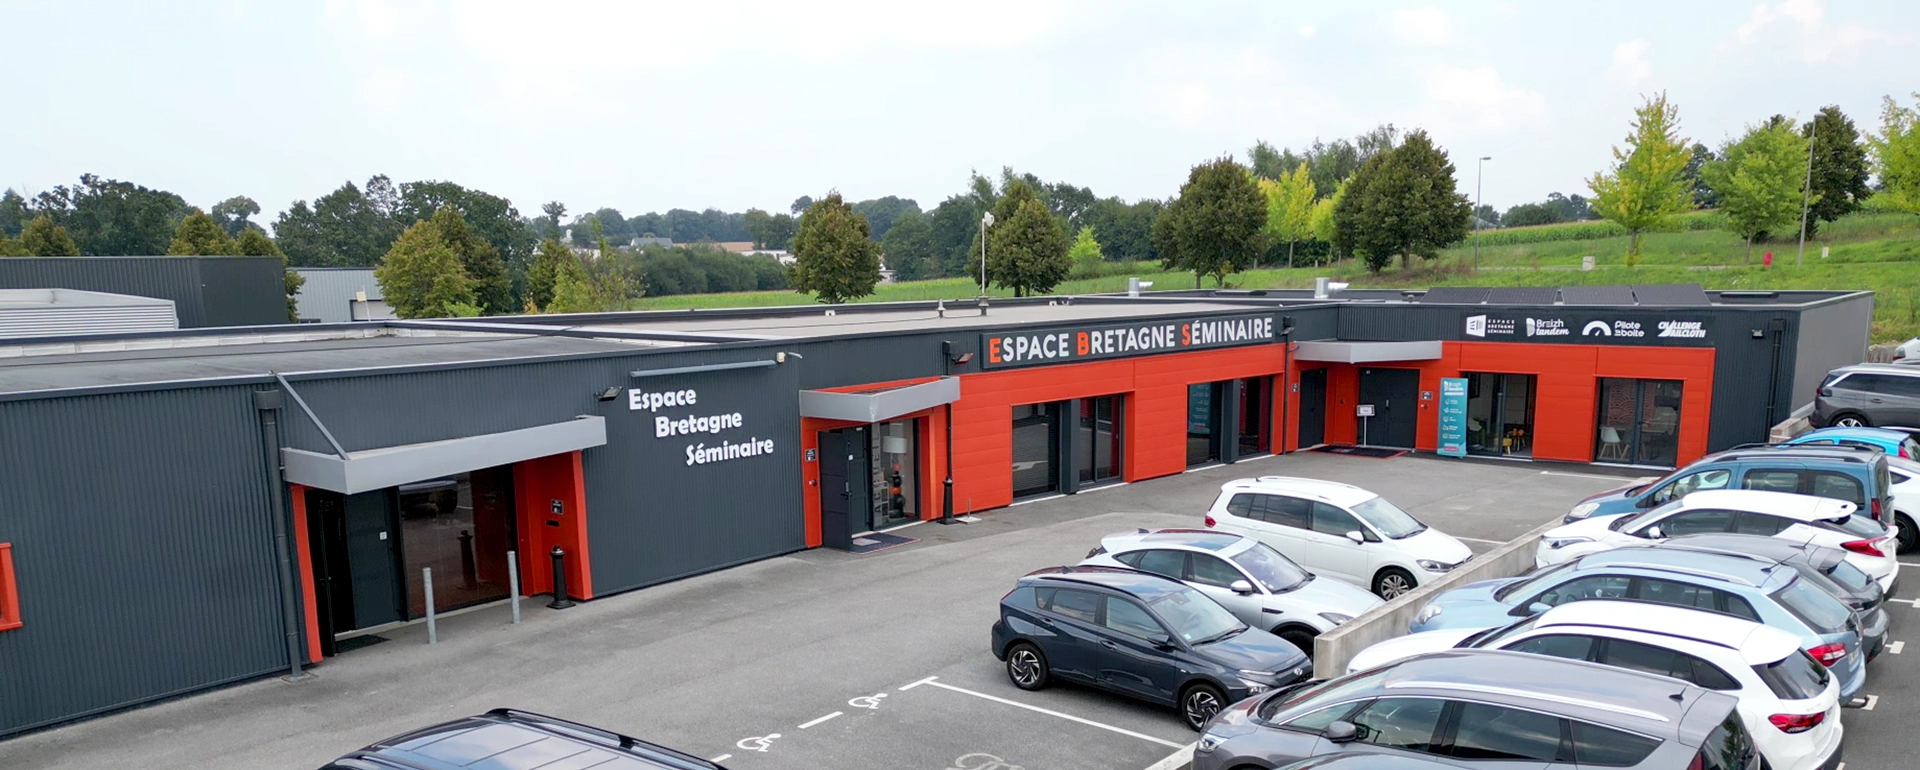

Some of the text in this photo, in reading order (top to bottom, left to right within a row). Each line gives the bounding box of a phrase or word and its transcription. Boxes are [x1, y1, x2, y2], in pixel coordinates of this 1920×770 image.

[1535, 327, 1570, 336] tandem
[1536, 318, 1564, 328] Breizh
[1615, 320, 1641, 329] Pilote
[989, 317, 1273, 363] ESPACE BRETAGNE SÉMINAIRE
[628, 388, 697, 412] Espace
[655, 412, 742, 438] Bretagne
[686, 437, 774, 466] Séminaire
